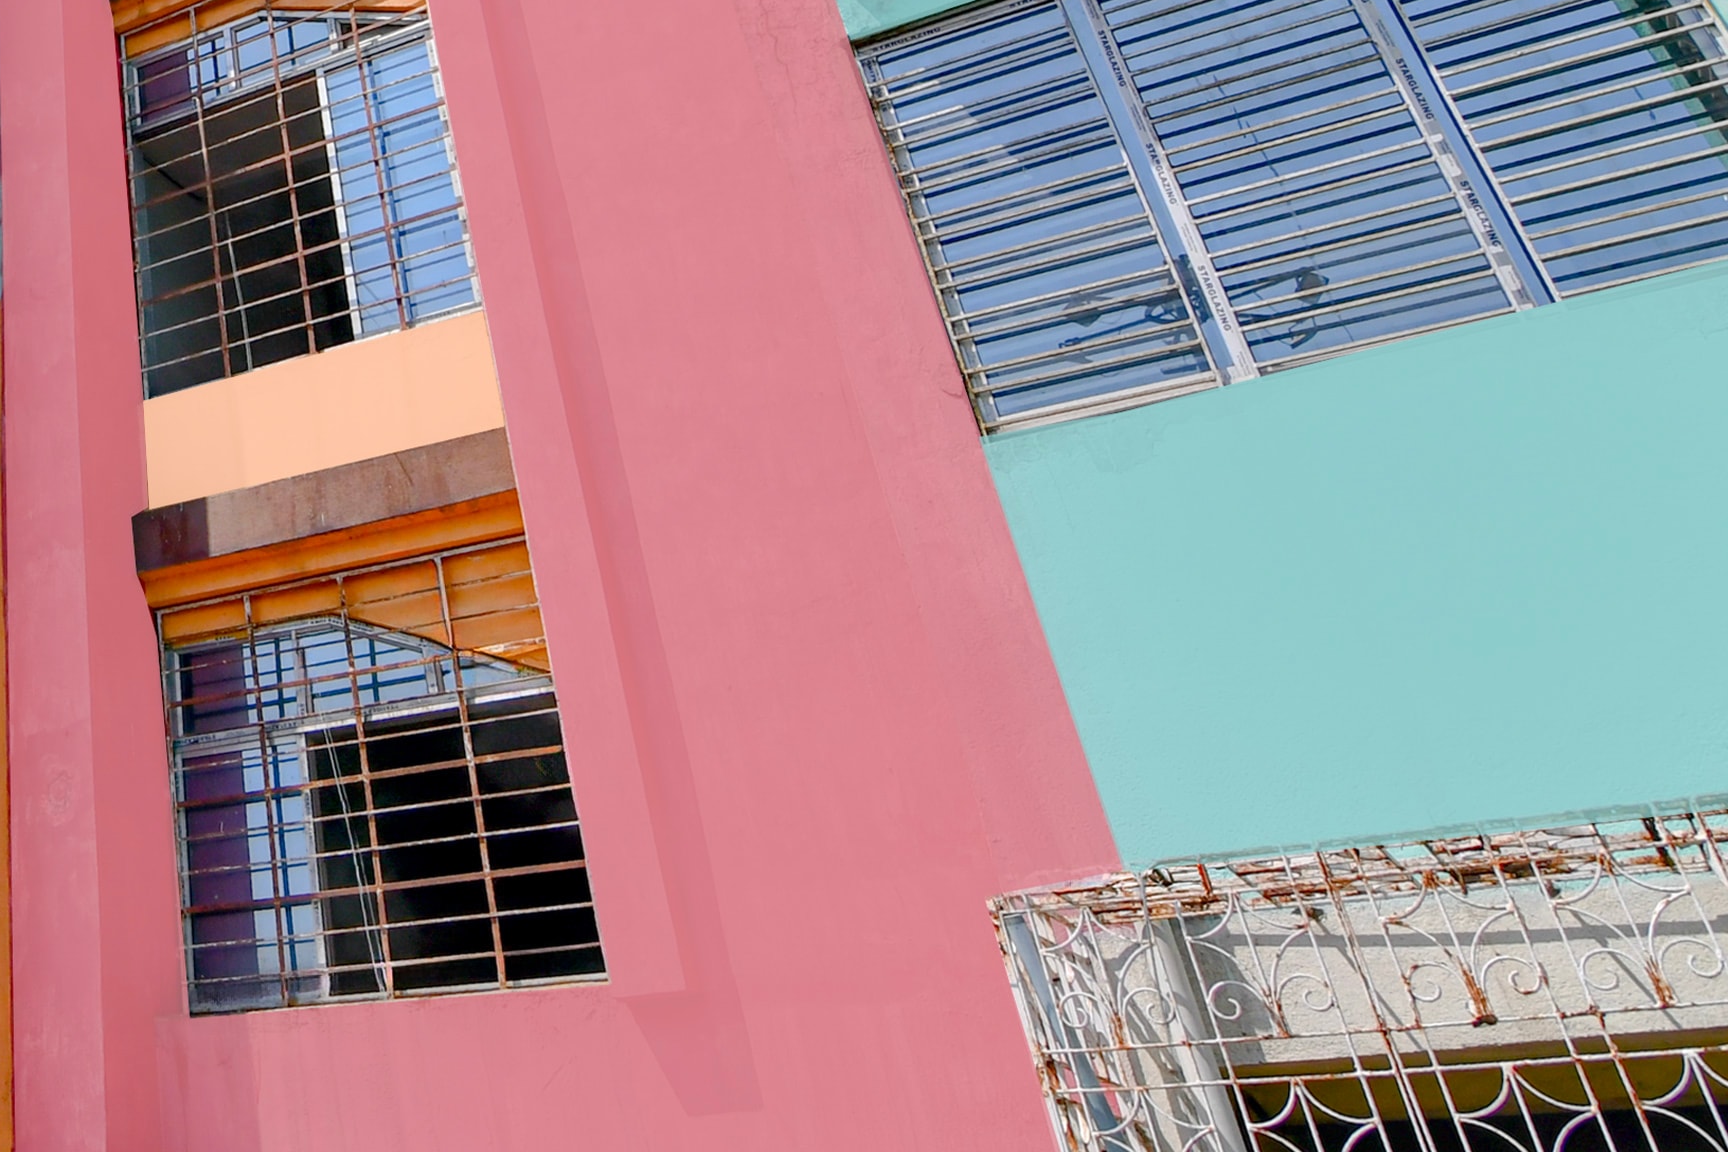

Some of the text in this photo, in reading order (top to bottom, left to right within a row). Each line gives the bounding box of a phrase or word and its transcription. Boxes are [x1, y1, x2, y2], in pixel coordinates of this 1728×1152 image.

[1097, 30, 1127, 88] STARGLAZING
[1395, 57, 1434, 120] STARGLAZING
[1460, 180, 1502, 247] STARGLAZING
[1197, 264, 1232, 332] STARGLAZING
